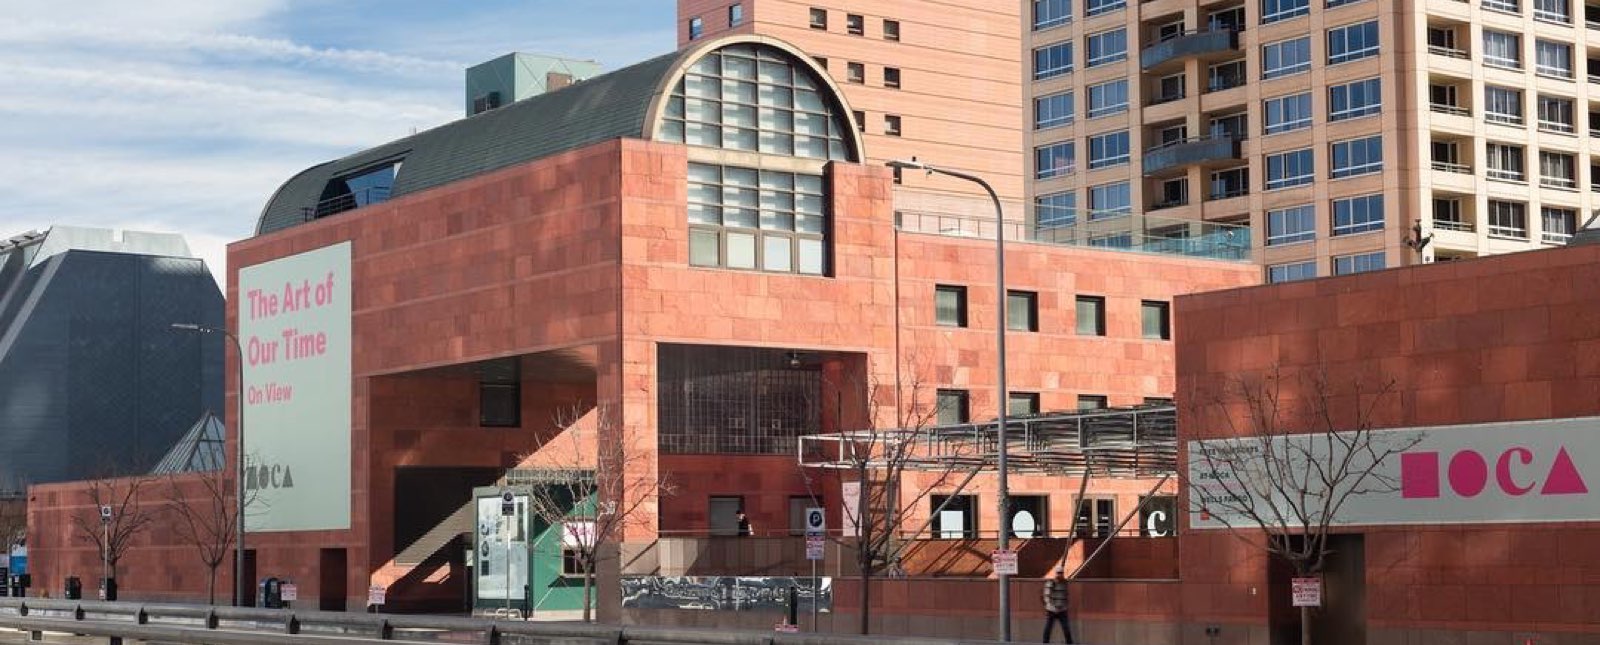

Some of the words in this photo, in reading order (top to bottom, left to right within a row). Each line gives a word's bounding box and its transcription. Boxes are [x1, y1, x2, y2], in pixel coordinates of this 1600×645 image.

[247, 288, 278, 320] The
[283, 279, 310, 313] Art
[315, 272, 333, 306] of
[248, 336, 278, 366] Our
[282, 328, 327, 360] Time
[248, 385, 262, 404] On
[265, 382, 292, 403] View
[246, 464, 293, 489] MOCA
[1401, 445, 1589, 498] MOCA
